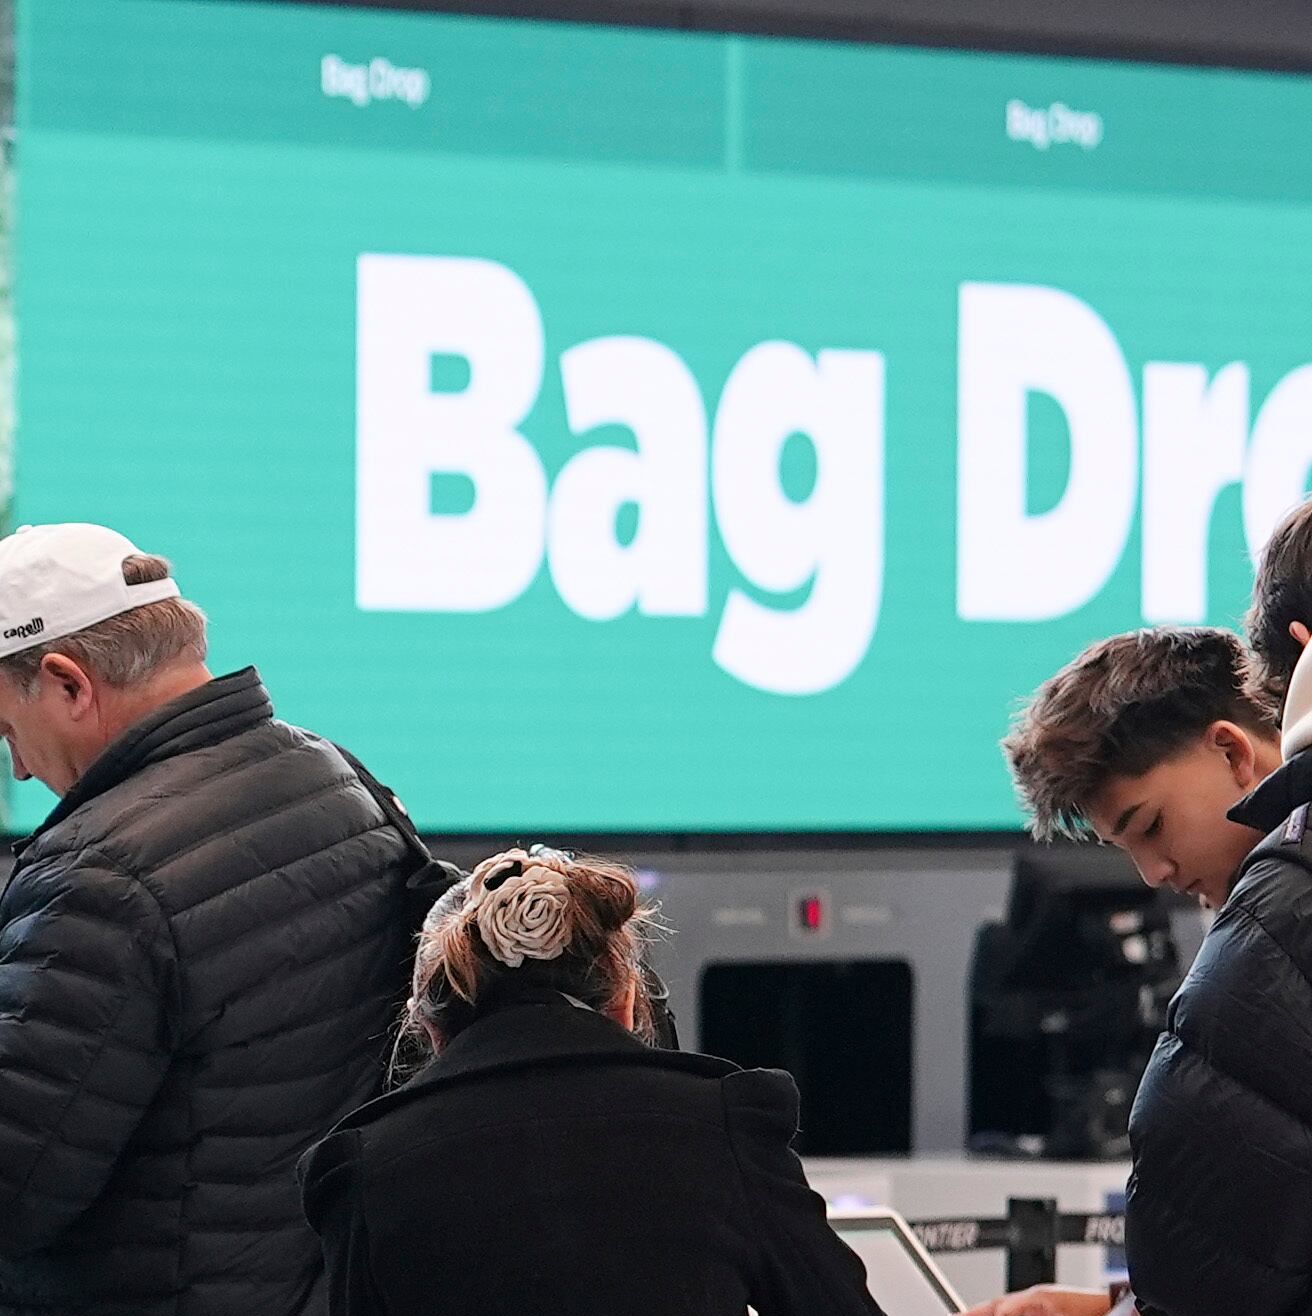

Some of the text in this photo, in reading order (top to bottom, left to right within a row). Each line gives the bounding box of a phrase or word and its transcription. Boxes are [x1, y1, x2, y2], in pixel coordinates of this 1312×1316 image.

[321, 54, 430, 109] Bag Drop
[1006, 99, 1103, 150] Bag Drop
[356, 253, 1312, 697] Bag Dr
